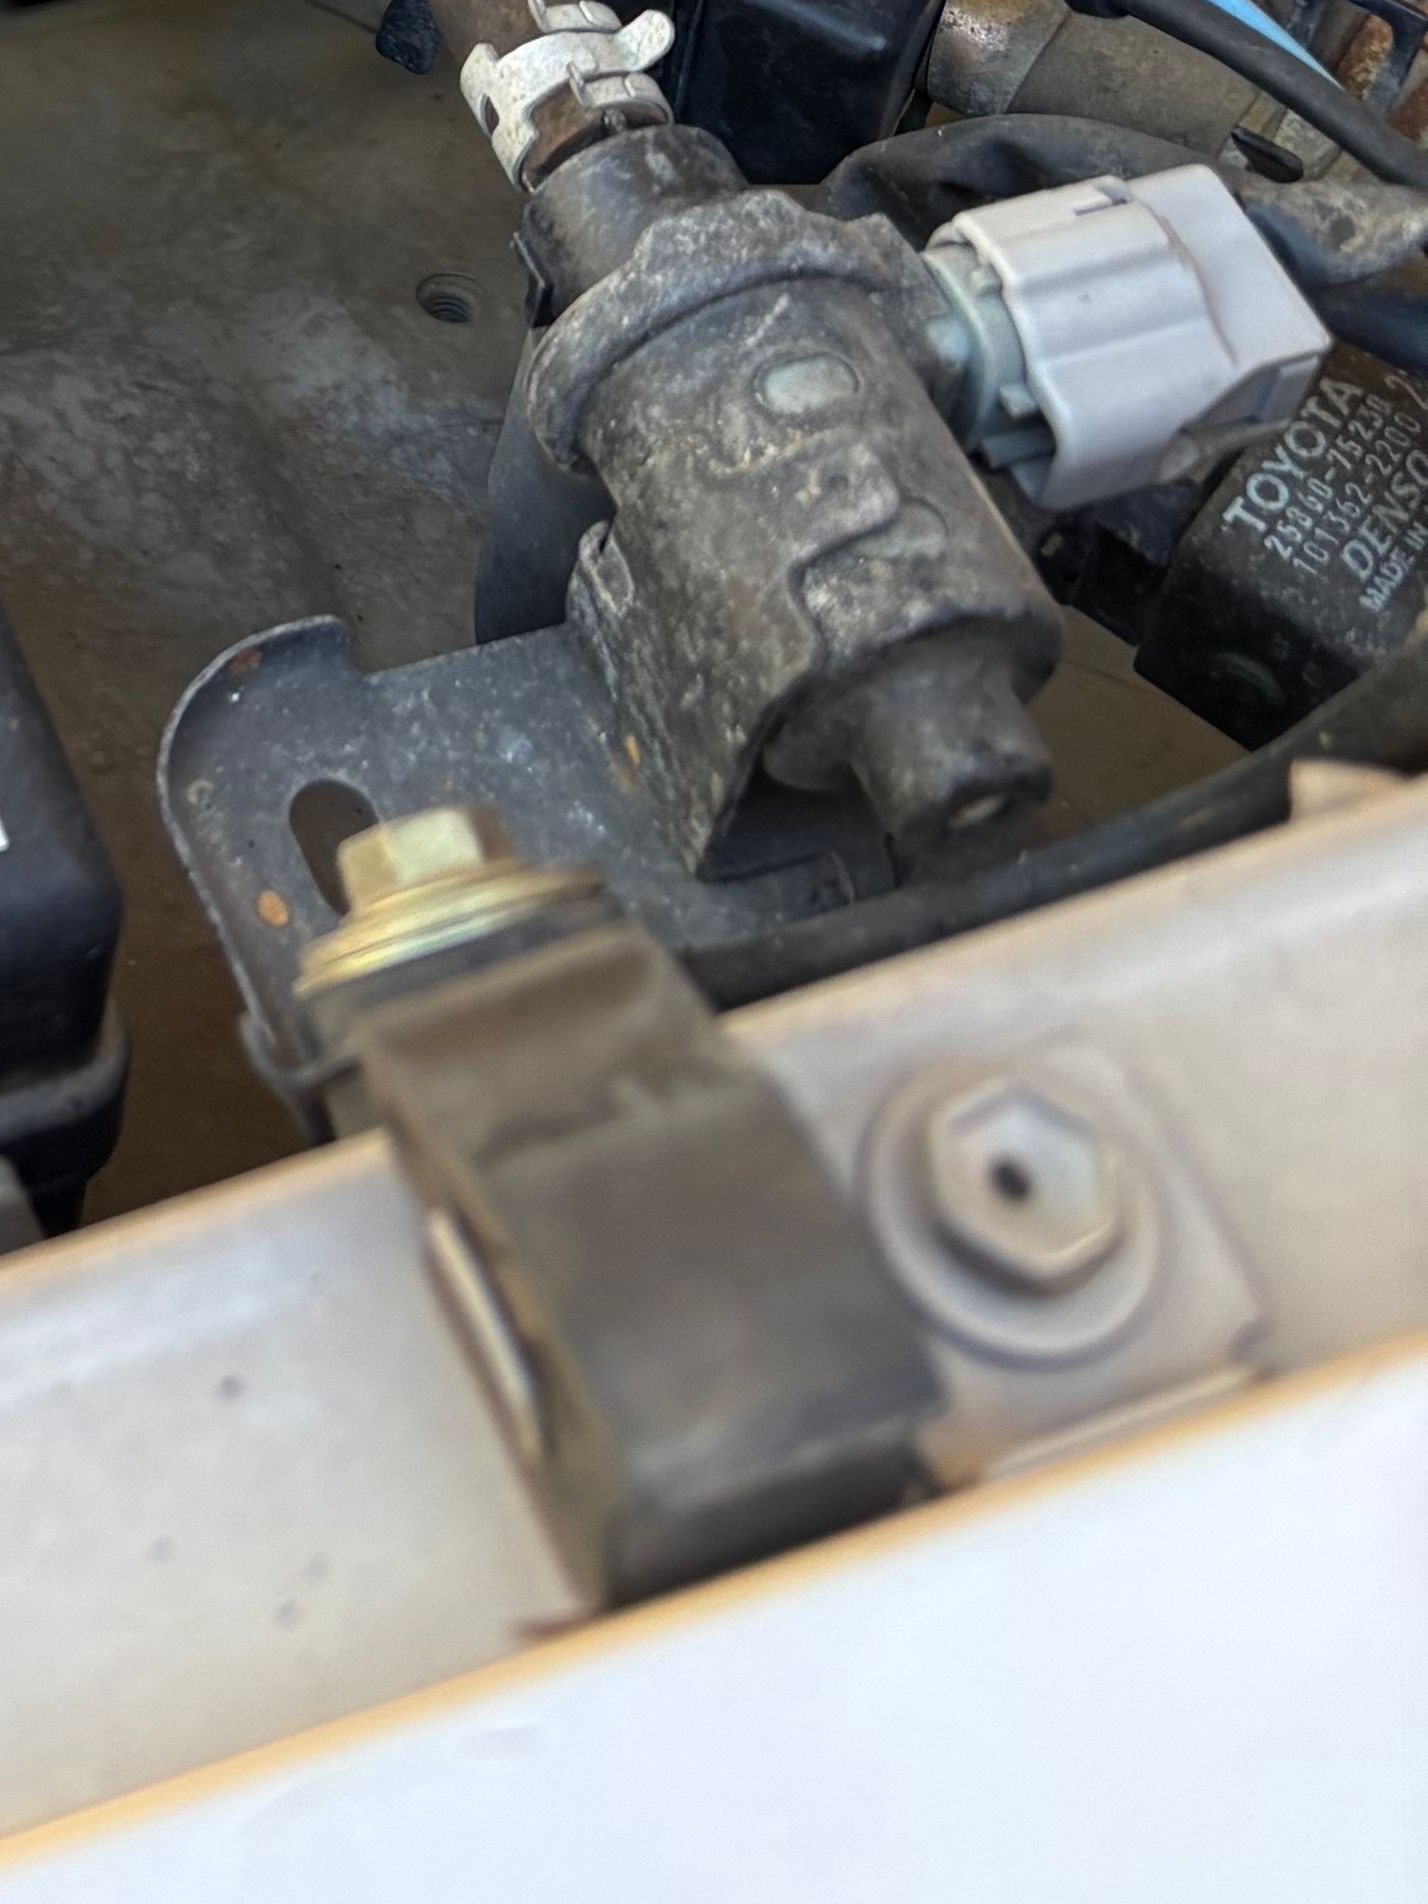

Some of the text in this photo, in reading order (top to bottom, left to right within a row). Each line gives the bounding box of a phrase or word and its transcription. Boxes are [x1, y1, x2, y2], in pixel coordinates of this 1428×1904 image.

[1221, 376, 1365, 533] TOYOTA
[1342, 448, 1428, 580] DENSO
[1359, 551, 1415, 613] MADE
